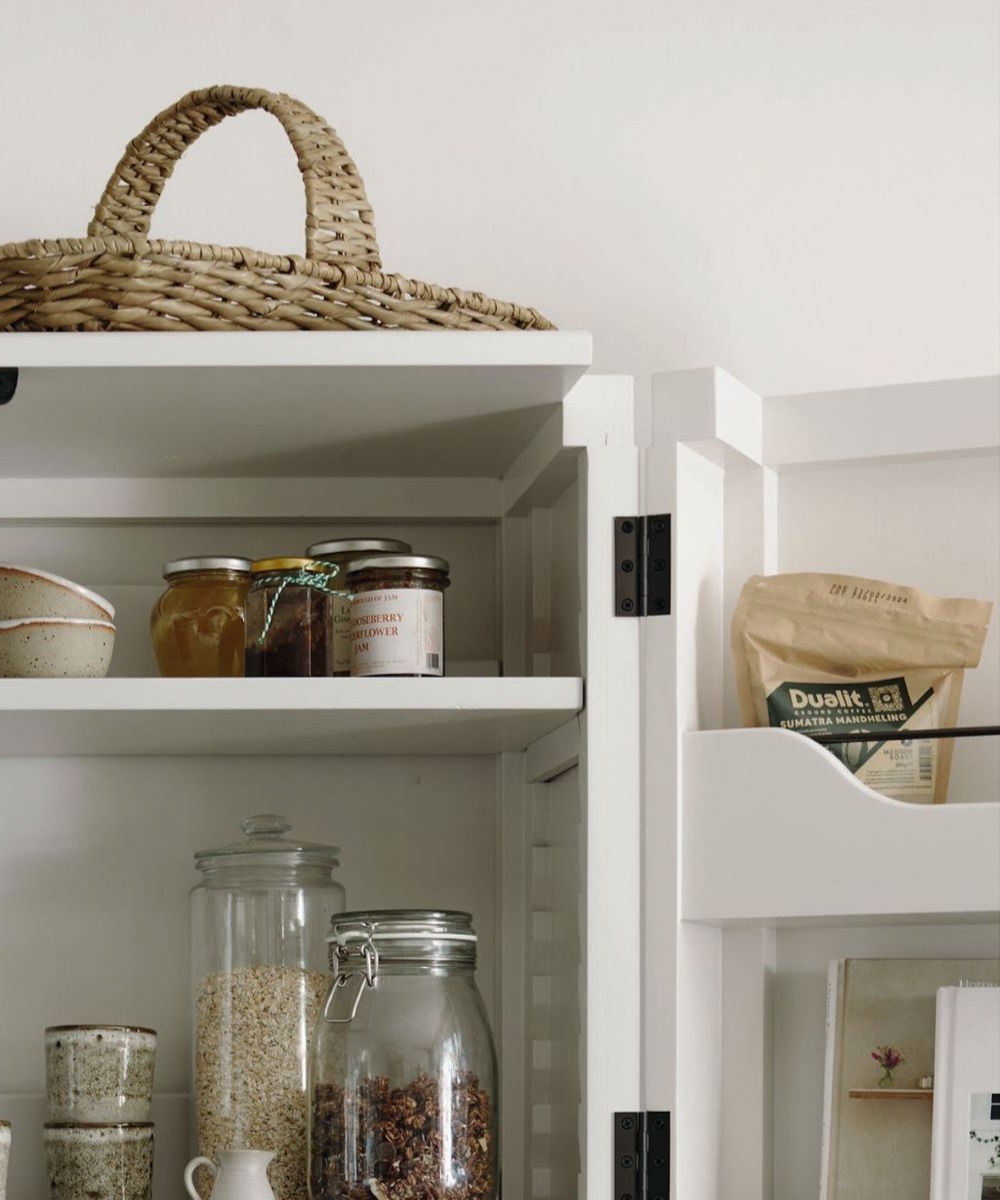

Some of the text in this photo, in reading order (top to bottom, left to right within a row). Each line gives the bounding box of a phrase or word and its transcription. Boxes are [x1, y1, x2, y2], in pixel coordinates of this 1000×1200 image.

[355, 642, 369, 654] JAM
[789, 688, 864, 709] Dualit
[780, 713, 908, 729] SUMATRA MANDHELING
